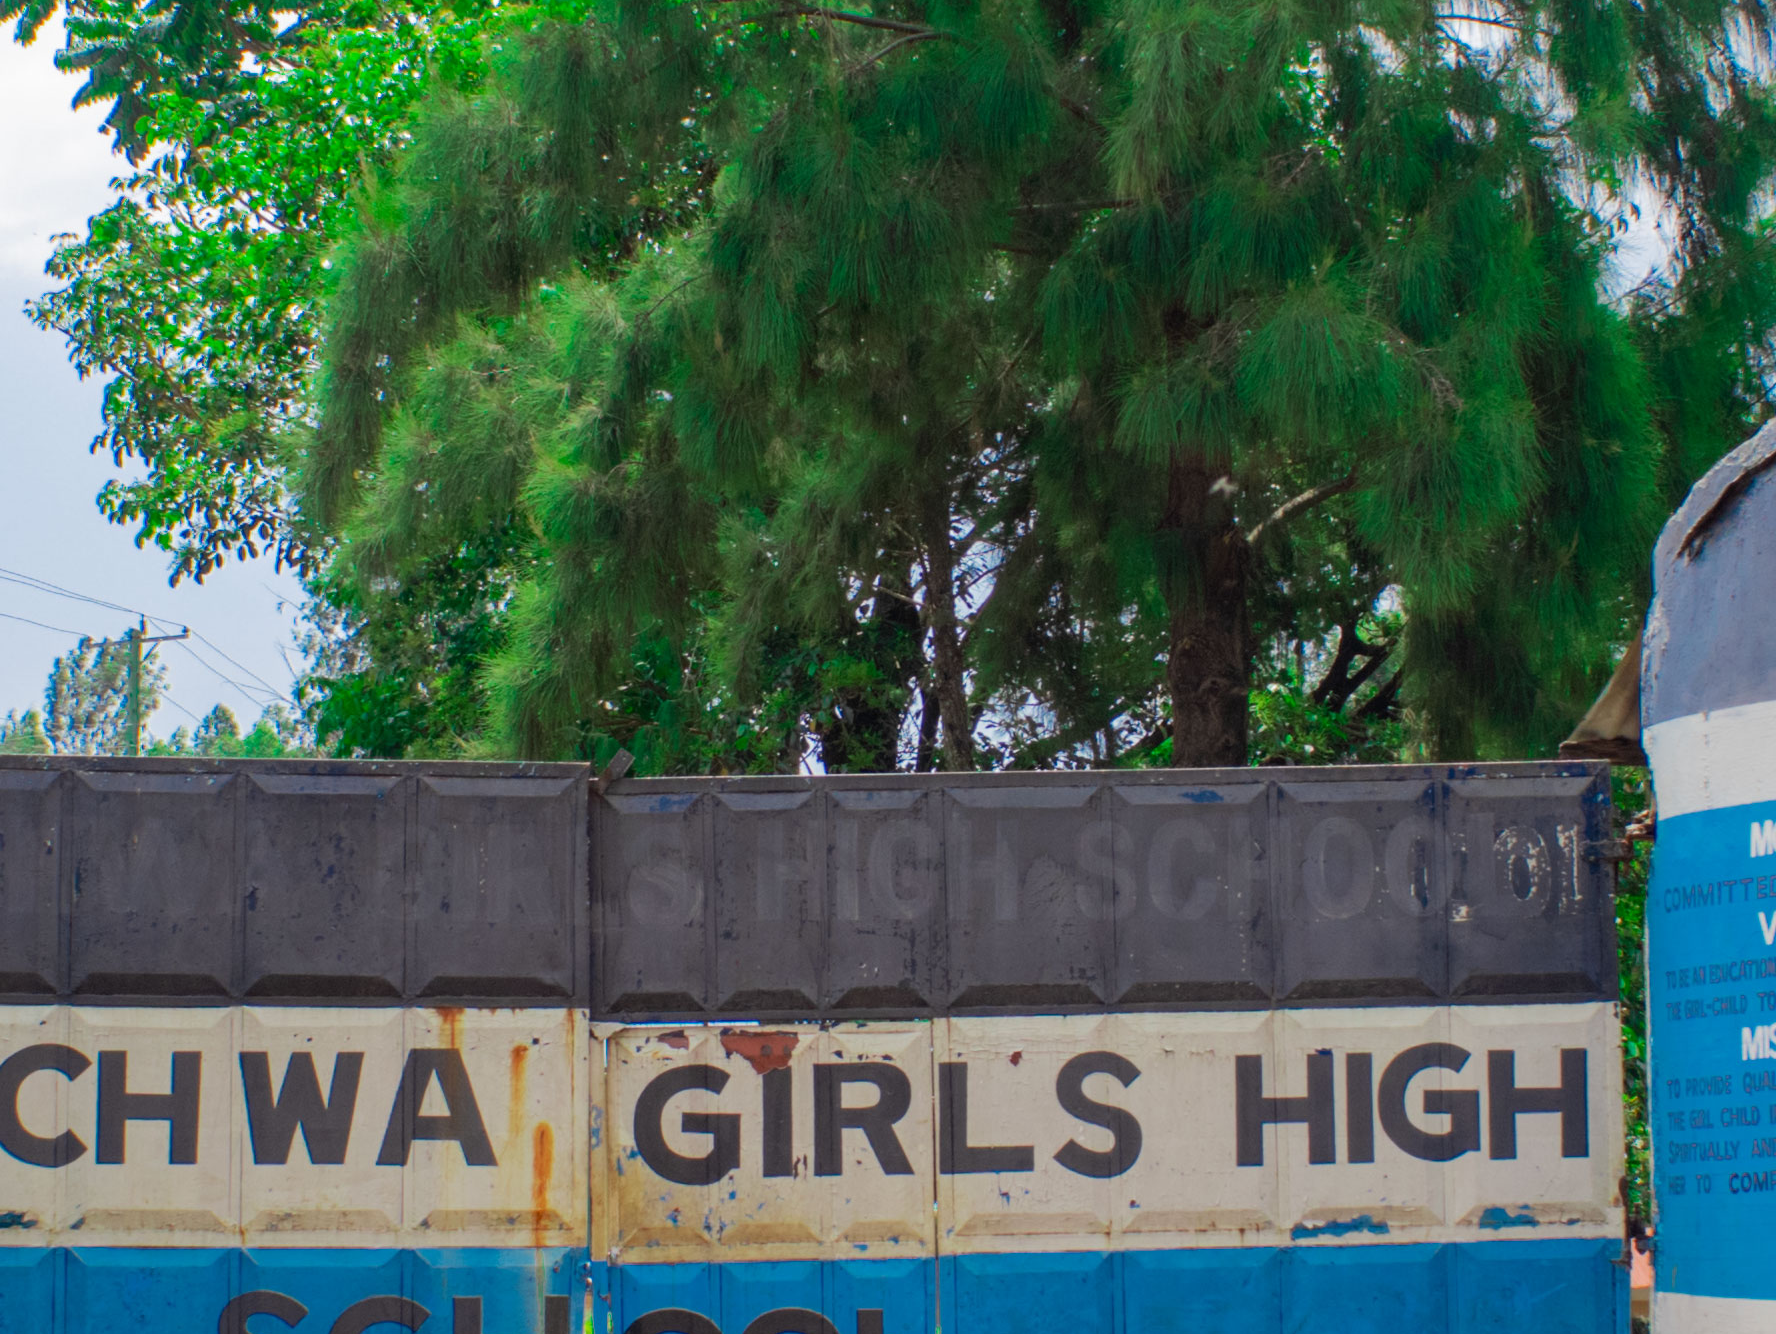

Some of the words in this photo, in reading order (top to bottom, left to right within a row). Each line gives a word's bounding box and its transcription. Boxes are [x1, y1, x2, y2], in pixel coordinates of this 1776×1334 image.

[1665, 970, 1677, 990] TO
[1679, 968, 1690, 988] BE
[1692, 966, 1706, 986] AN
[1666, 1001, 1681, 1021] THE
[1684, 994, 1747, 1019] GIRL-CHILD
[1757, 990, 1776, 1012] TO
[1666, 1079, 1680, 1099] TO
[1685, 1074, 1732, 1096] PROVIDE
[633, 1050, 1144, 1186] GIRLS
[1235, 1042, 1591, 1166] HIGH
[1668, 1111, 1685, 1131] THE
[1689, 1109, 1713, 1129] GIRL
[1720, 1106, 1760, 1128] CHILD
[1669, 1140, 1740, 1164] SPIRITUALLY
[1668, 1175, 1686, 1195] HER
[1696, 1174, 1712, 1194] TO
